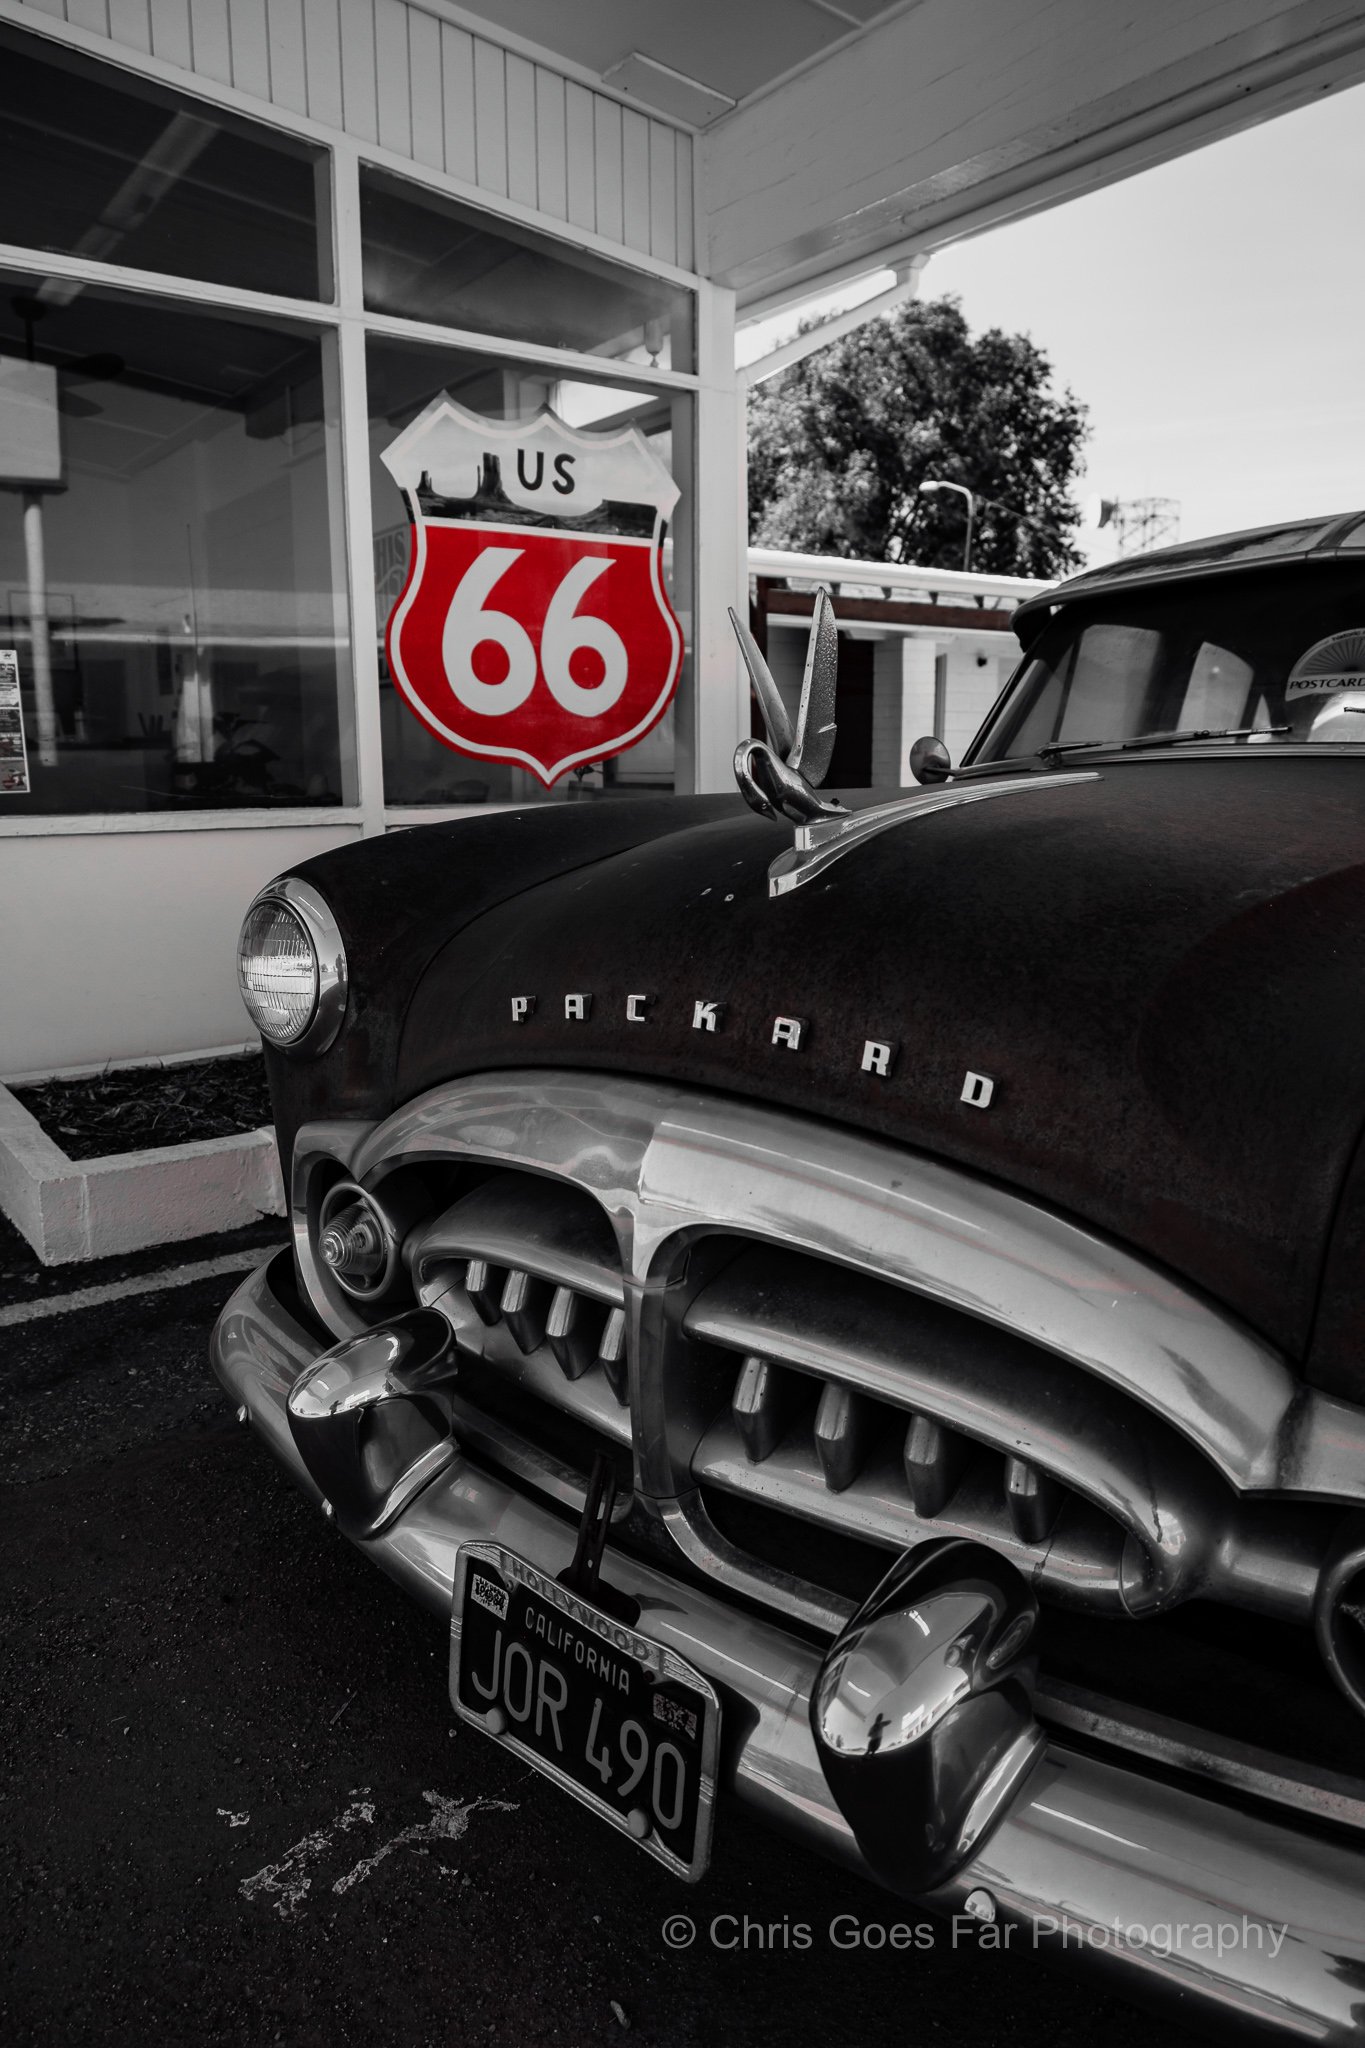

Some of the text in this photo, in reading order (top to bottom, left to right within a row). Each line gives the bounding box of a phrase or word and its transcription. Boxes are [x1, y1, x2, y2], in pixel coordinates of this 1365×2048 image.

[516, 448, 577, 495] US
[441, 546, 629, 718] 66
[510, 993, 996, 1109] PACKARD
[512, 1562, 650, 1661] HOLLYWOOD
[525, 1606, 631, 1697] CALIFORNIA
[471, 1629, 687, 1830] JOR 490
